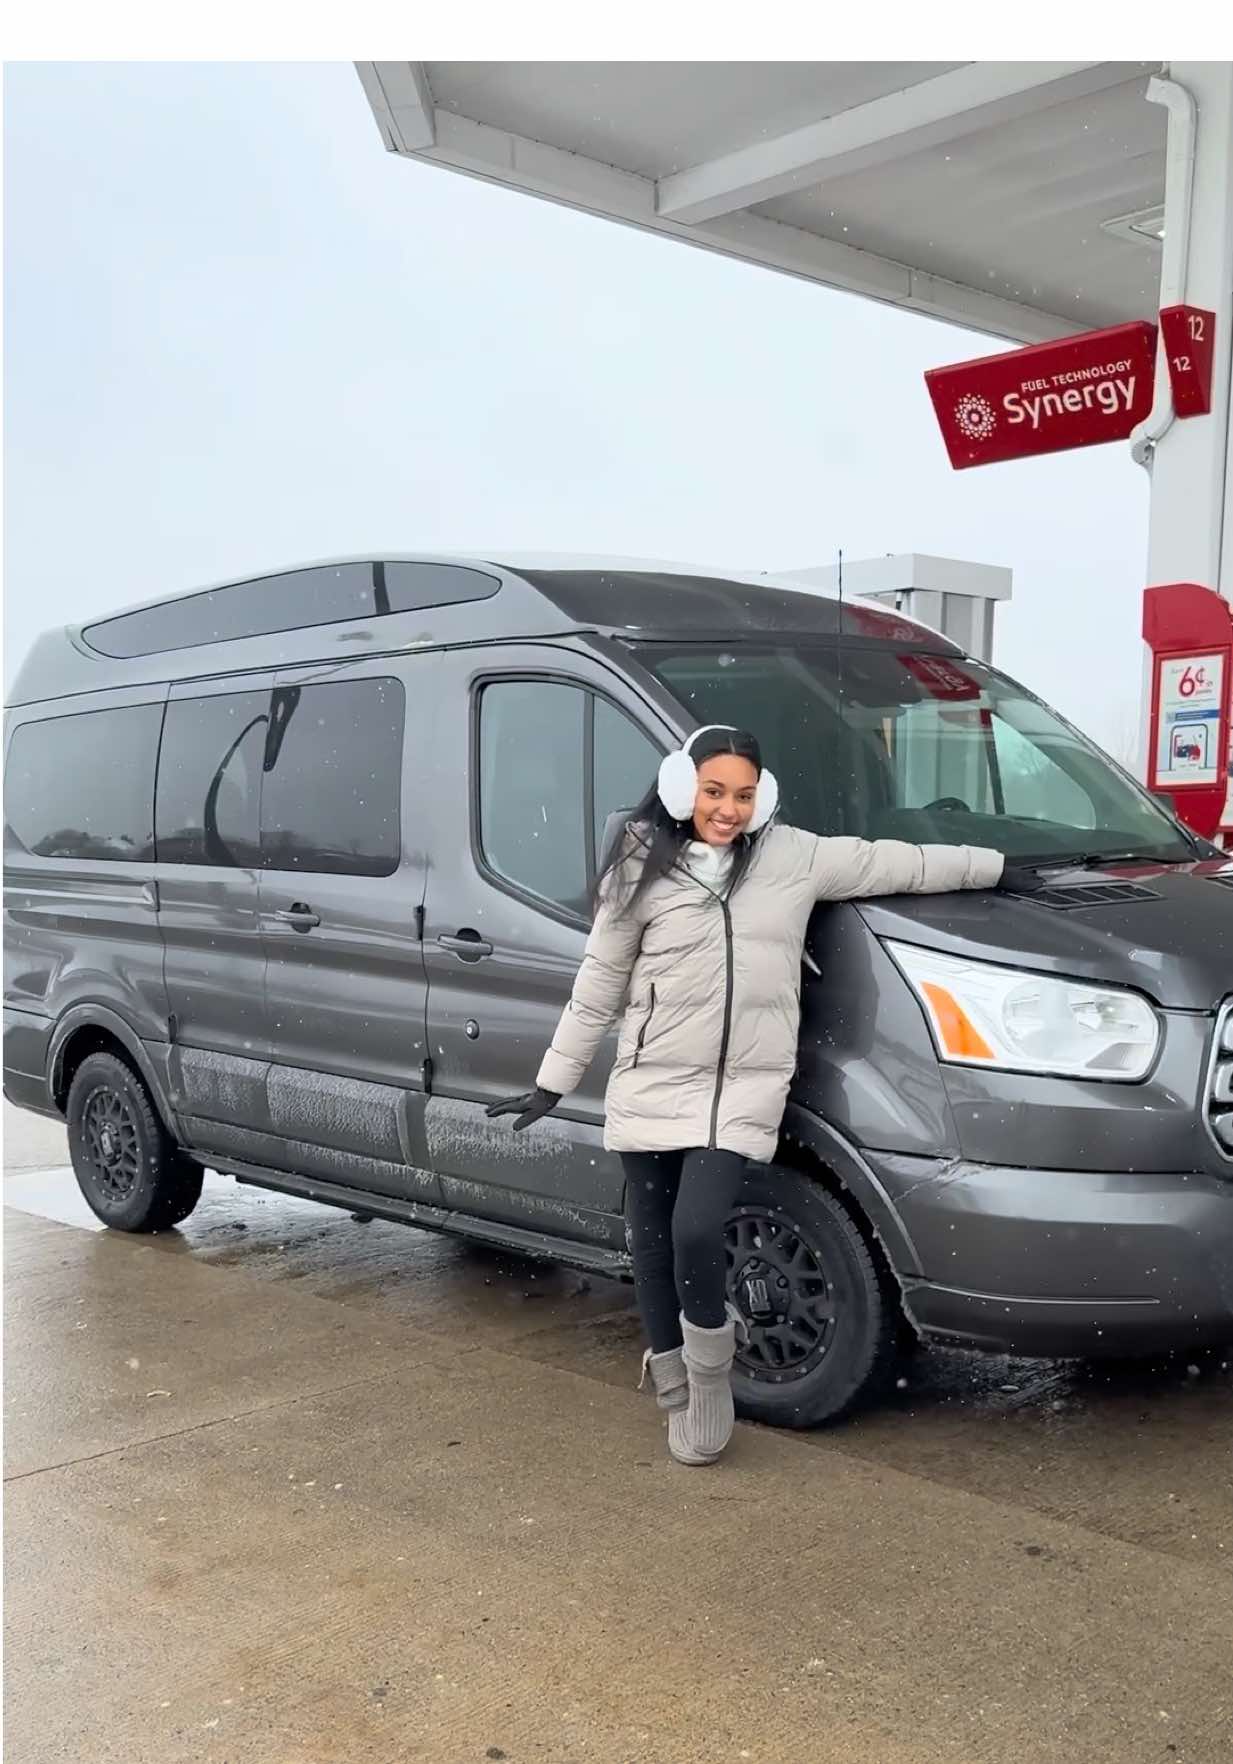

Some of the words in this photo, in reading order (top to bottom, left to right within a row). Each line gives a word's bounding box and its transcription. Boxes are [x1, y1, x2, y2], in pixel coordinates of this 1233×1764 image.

[1188, 315, 1204, 342] 12
[1021, 379, 1050, 393] FUEL
[1051, 359, 1132, 386] TECHNOLOGY
[1173, 356, 1191, 373] 12
[1003, 376, 1136, 429] Synergy
